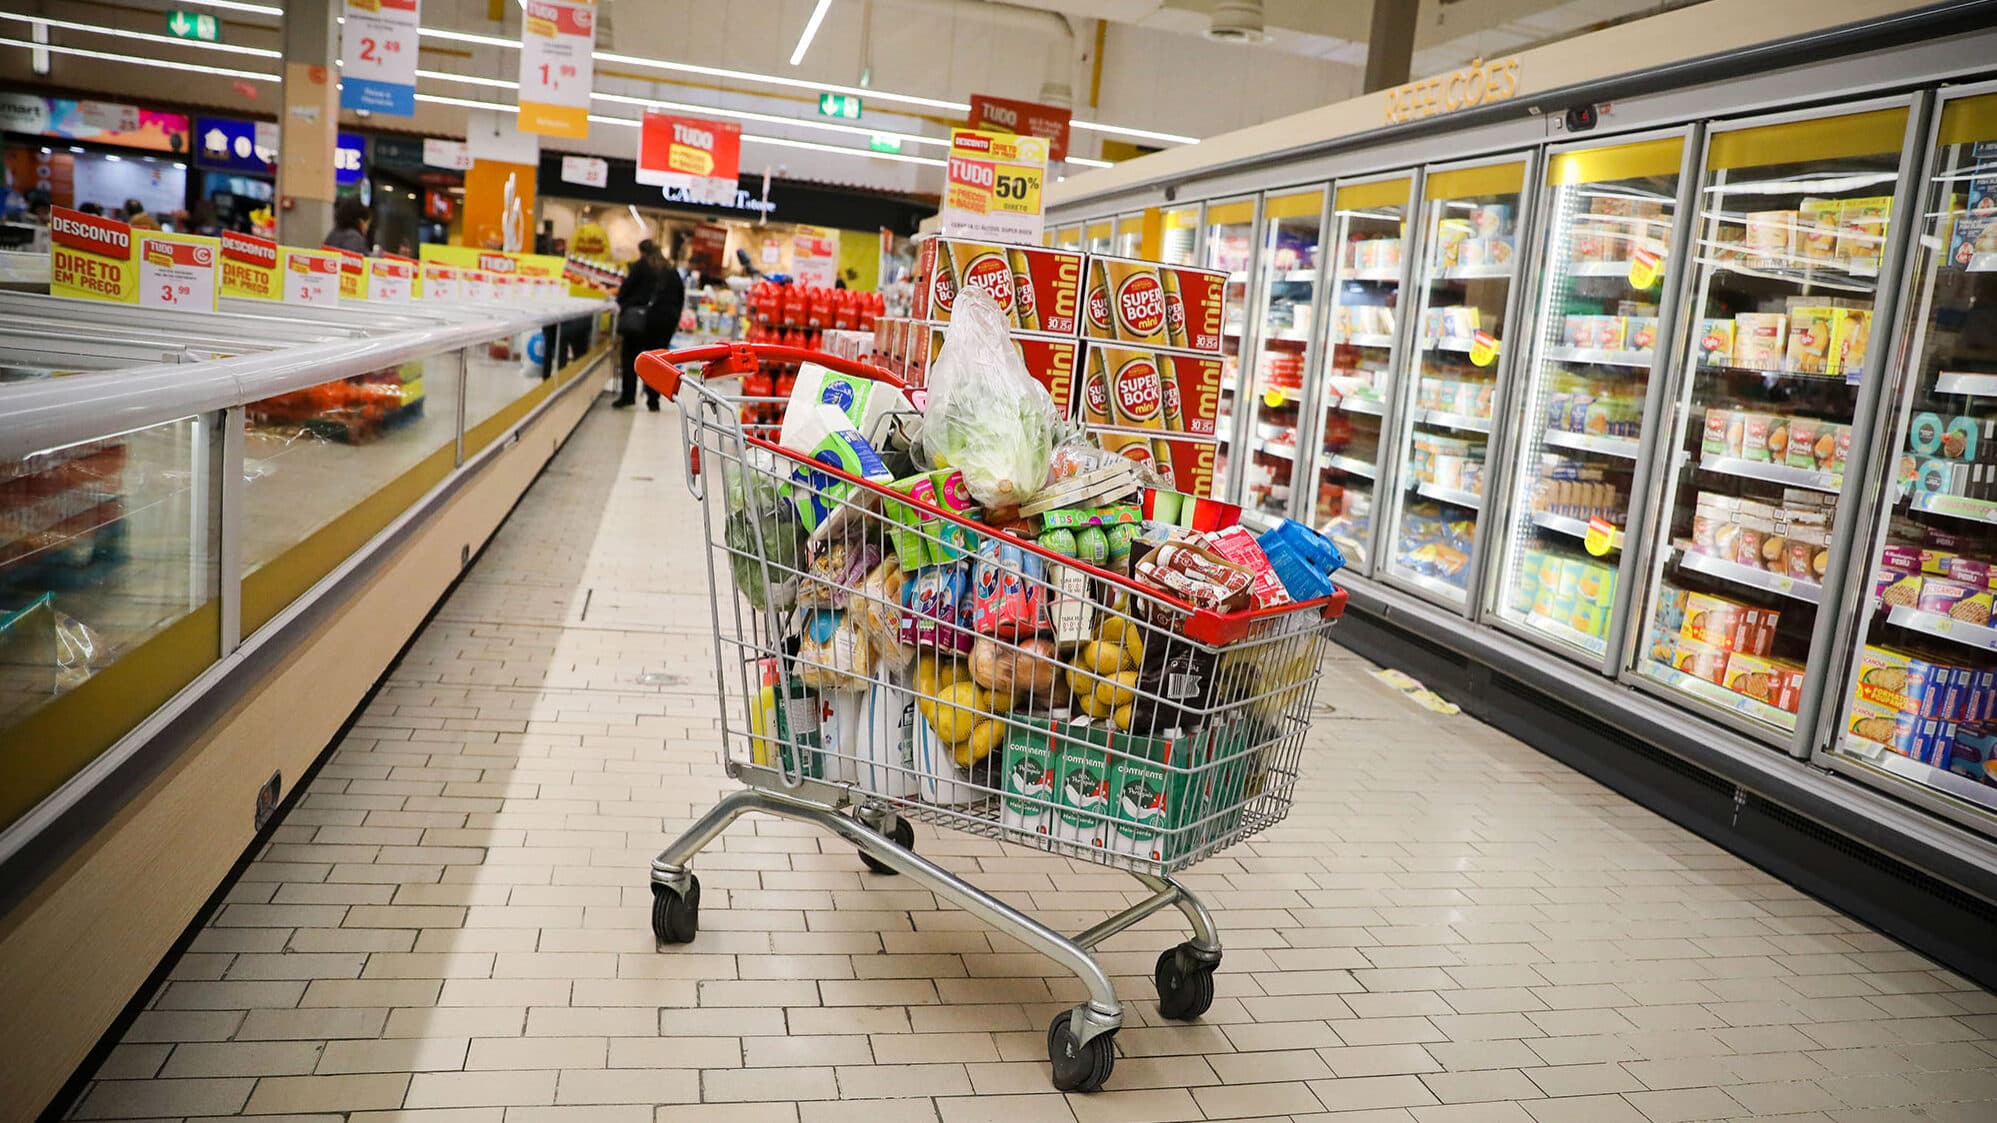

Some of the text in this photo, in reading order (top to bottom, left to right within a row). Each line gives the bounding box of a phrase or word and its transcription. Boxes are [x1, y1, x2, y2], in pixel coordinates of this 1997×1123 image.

[981, 103, 1018, 126] TUDO
[672, 123, 714, 149] TUDO
[950, 159, 993, 187] TUDO
[995, 174, 1040, 200] 50%
[53, 216, 129, 248] DESCONTO
[222, 236, 276, 260] DESCONTO
[55, 252, 121, 283] DIRETO
[223, 262, 269, 285] DIRETO
[968, 268, 1012, 288] SUPER
[55, 270, 121, 296] EM PREÇO
[987, 282, 1012, 299] OCK
[1051, 255, 1080, 317] mini
[1122, 287, 1162, 308] SUPER
[1201, 274, 1226, 335] mini
[1126, 302, 1163, 321] BOCK
[1138, 316, 1158, 329] mini
[1046, 343, 1073, 404] mini
[1119, 373, 1159, 394] SUPER
[1123, 388, 1160, 407] BOCK
[1196, 360, 1222, 419] mini
[1134, 402, 1154, 415] mini
[1191, 443, 1216, 498] mini
